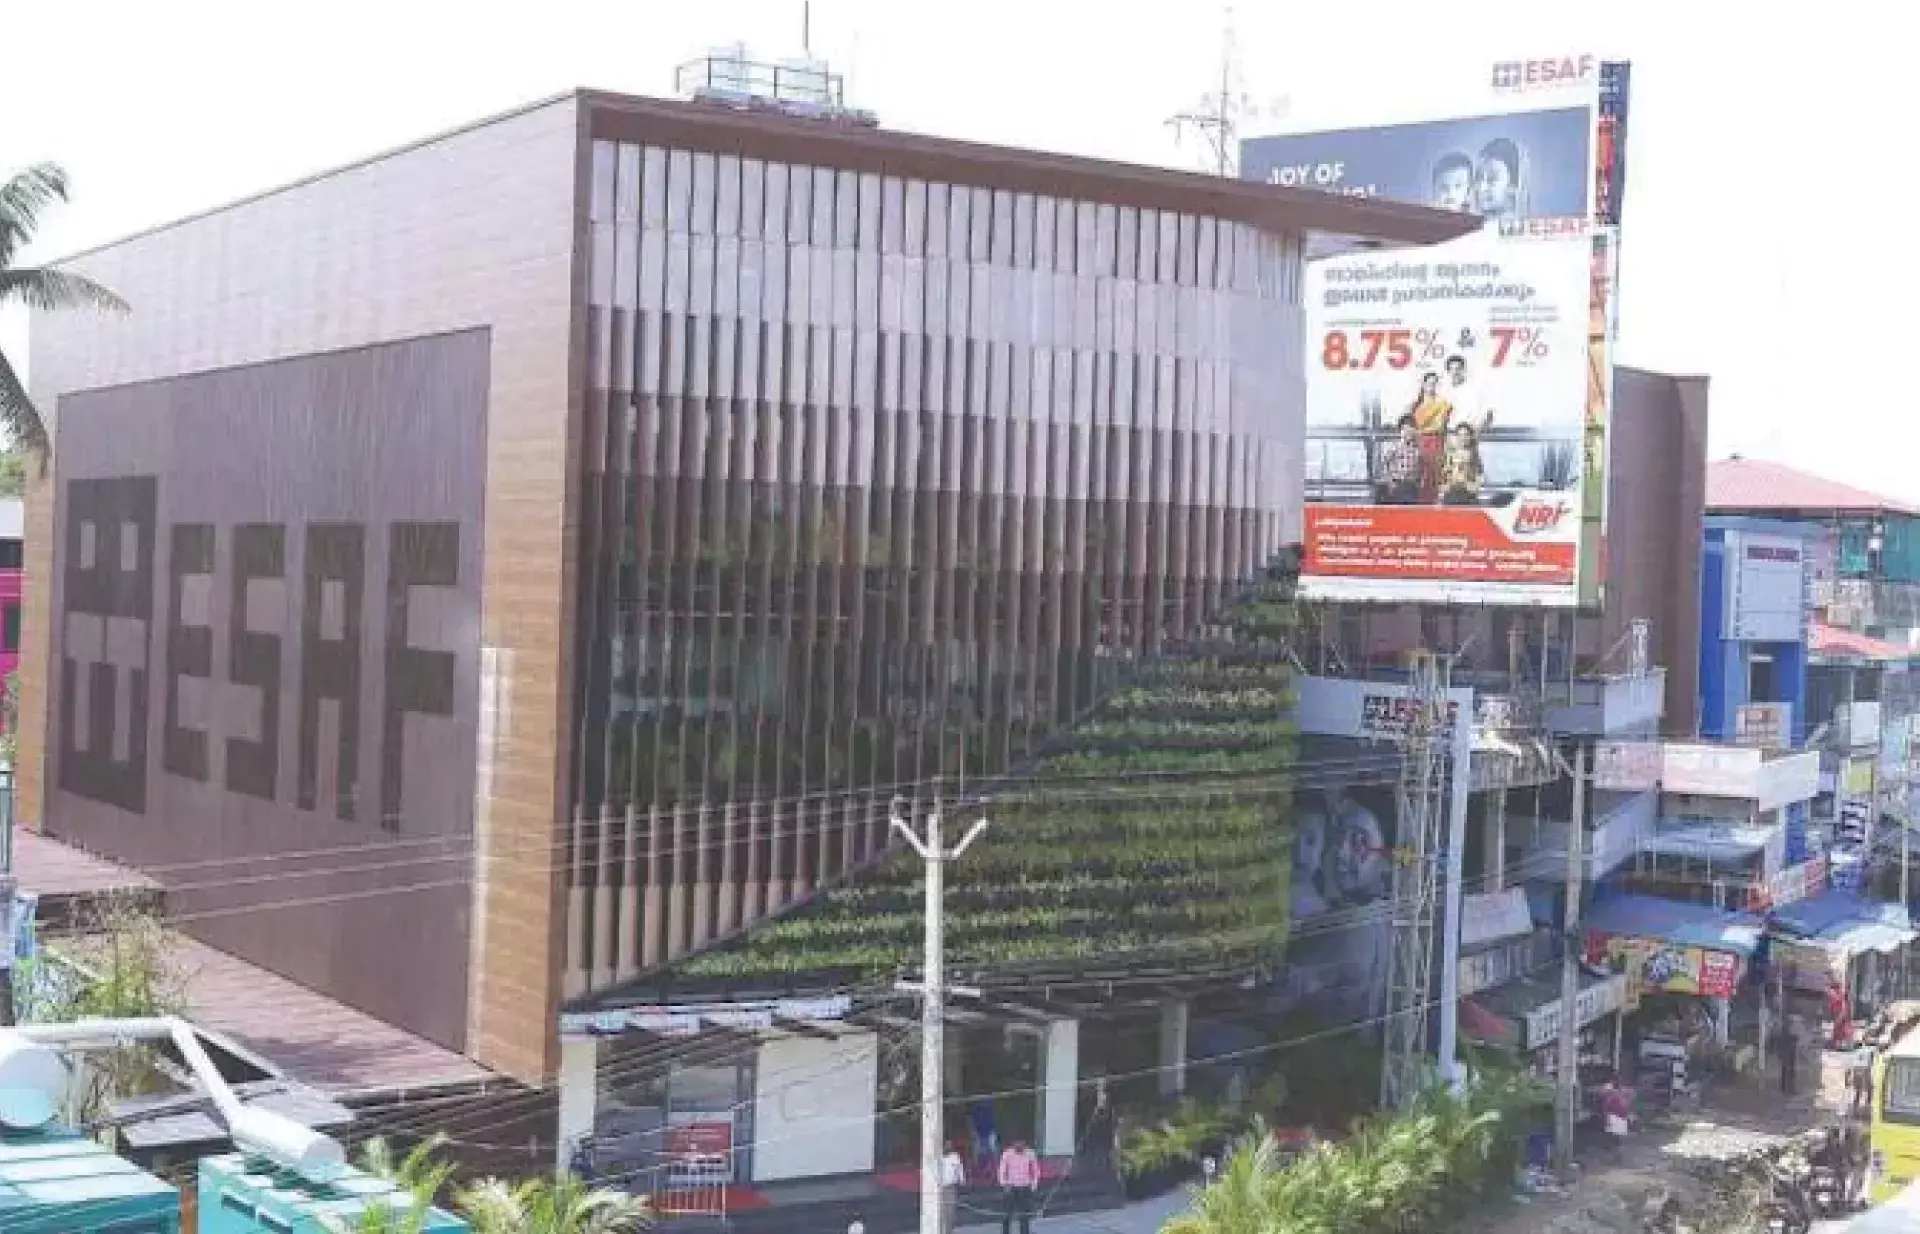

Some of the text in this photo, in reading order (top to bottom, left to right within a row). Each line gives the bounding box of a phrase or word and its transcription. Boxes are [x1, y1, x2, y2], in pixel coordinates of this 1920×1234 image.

[1526, 53, 1592, 82] ESAF
[1315, 161, 1344, 185] OF
[163, 522, 460, 834] ESAF
